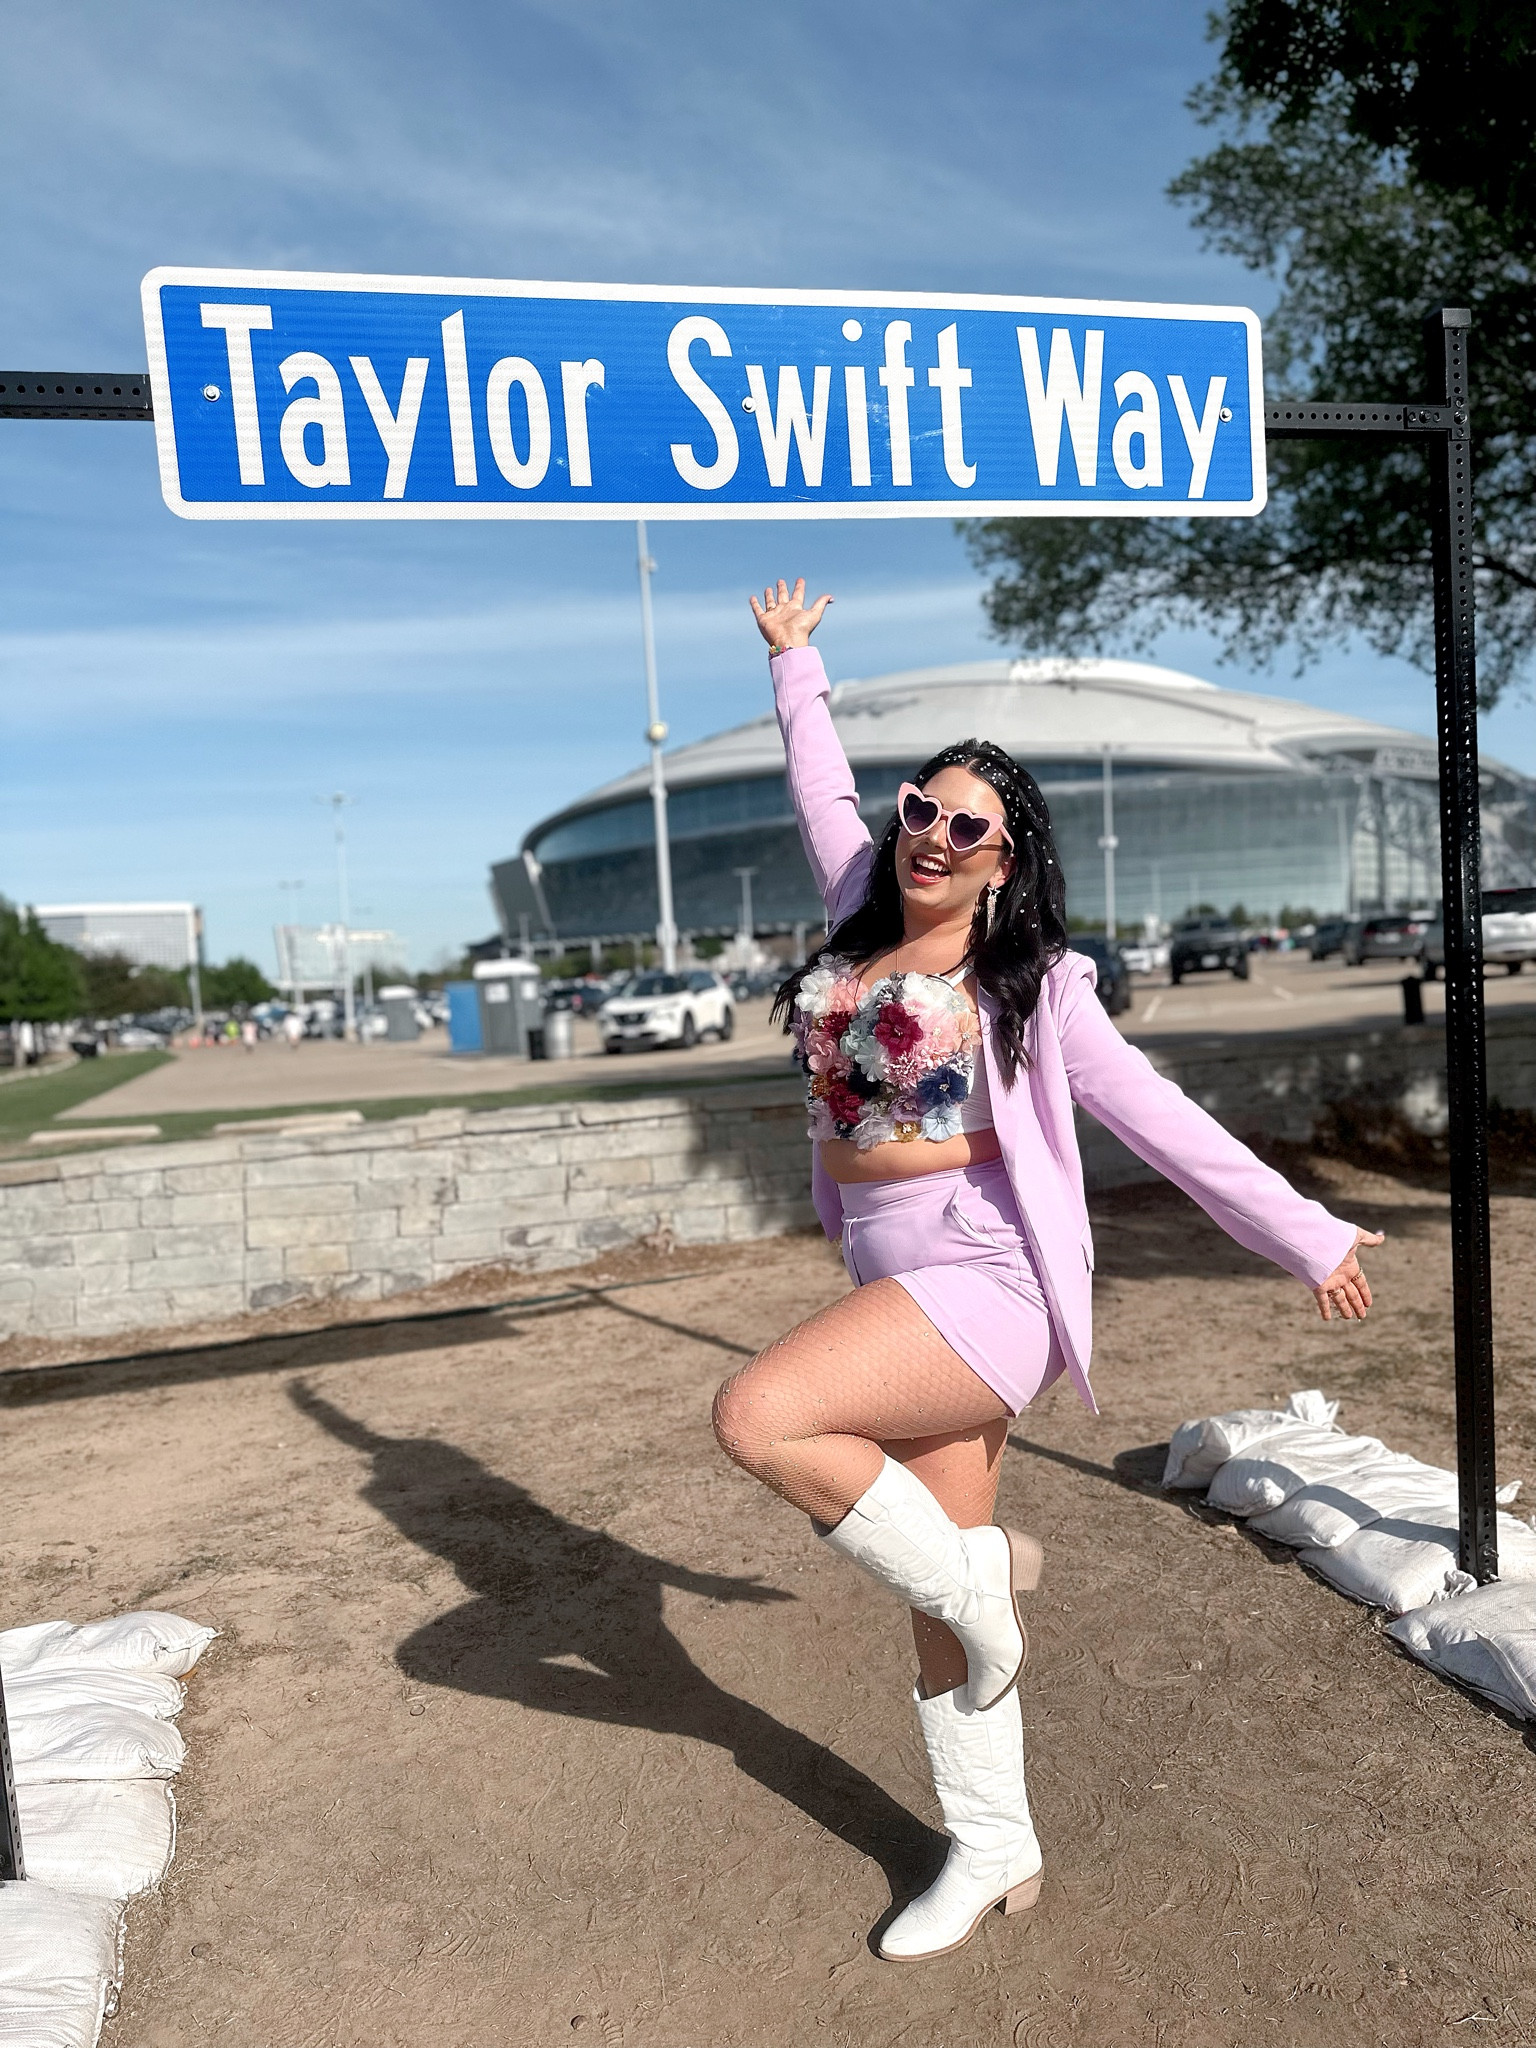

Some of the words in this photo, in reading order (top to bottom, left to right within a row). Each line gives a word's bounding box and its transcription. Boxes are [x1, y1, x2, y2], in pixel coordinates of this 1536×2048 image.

[200, 303, 605, 498] Taylor
[667, 316, 977, 490] Swift
[1016, 326, 1228, 498] Way
